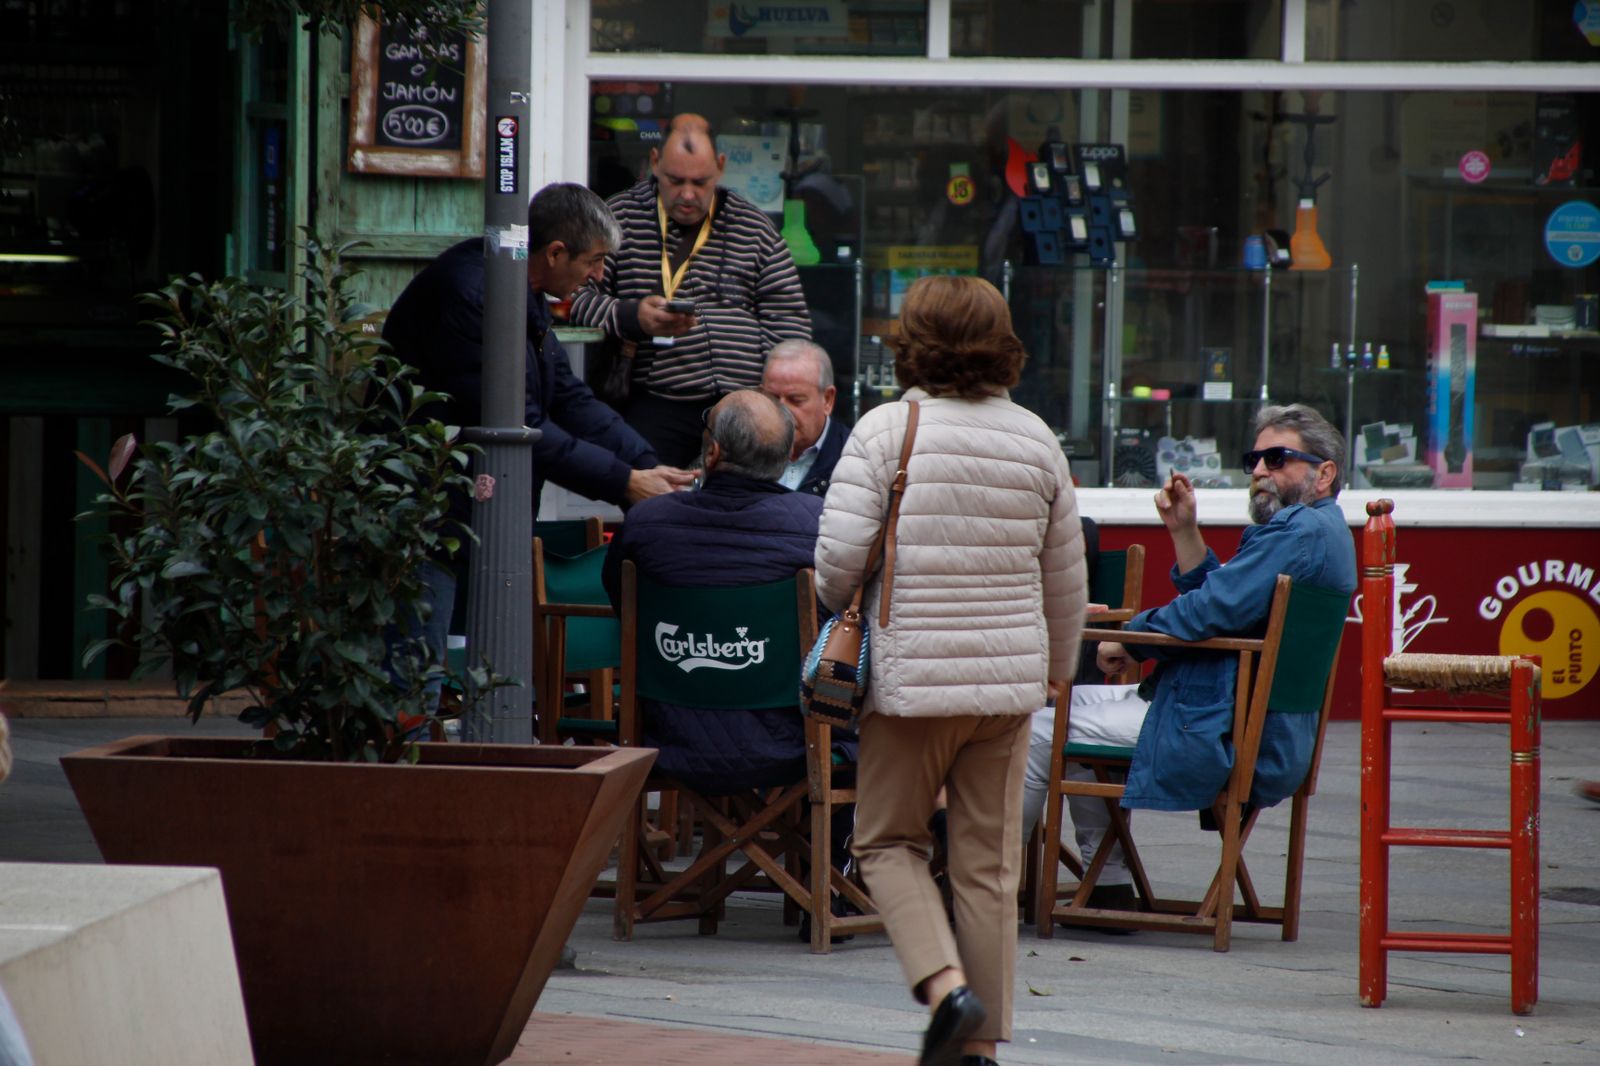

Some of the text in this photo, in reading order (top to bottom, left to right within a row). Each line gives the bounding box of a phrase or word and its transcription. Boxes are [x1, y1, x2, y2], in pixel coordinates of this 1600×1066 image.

[758, 7, 831, 23] HUELVA
[385, 43, 459, 62] GAMAS
[383, 81, 456, 102] JAMÓN
[500, 137, 514, 193] STOP ISLAM
[1478, 559, 1600, 621] GOURM
[655, 621, 766, 673] Carlsberg
[1569, 629, 1582, 684] PUNTO
[1552, 669, 1565, 684] EL
